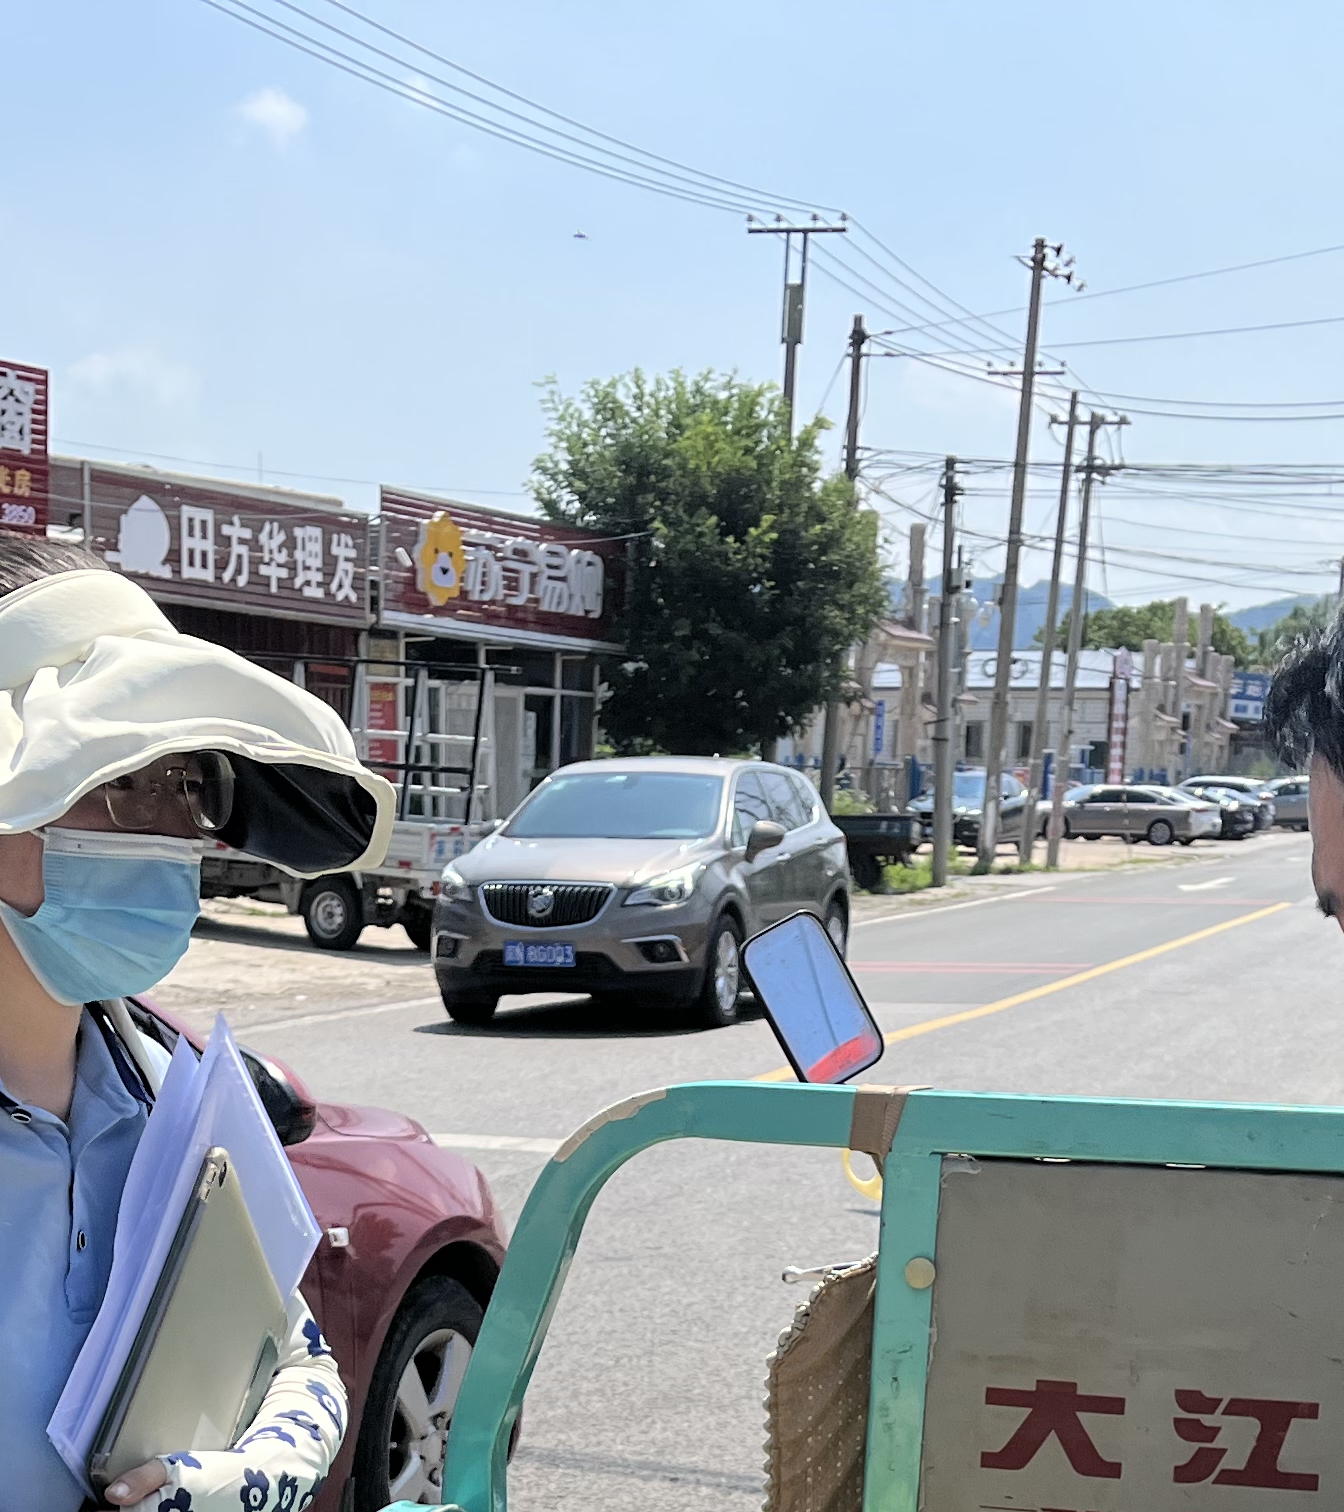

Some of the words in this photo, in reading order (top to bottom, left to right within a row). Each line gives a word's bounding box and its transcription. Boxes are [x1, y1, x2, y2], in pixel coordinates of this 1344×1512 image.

[180, 504, 357, 603] 田方华理发
[463, 529, 605, 618] 苏宁易购
[981, 1379, 1320, 1491] 大江
